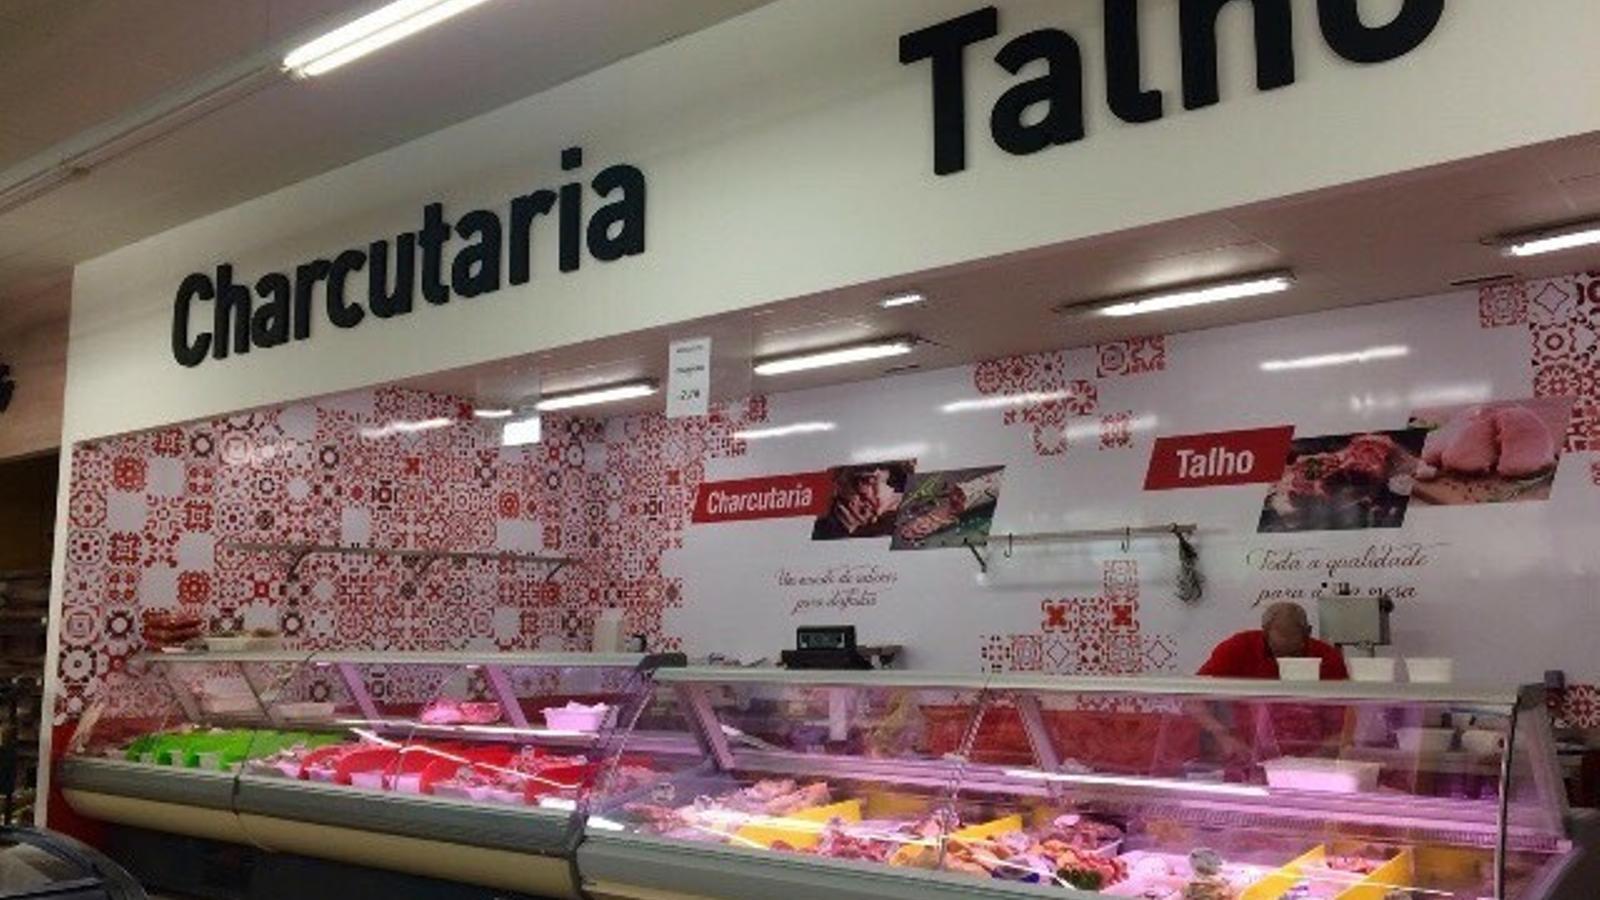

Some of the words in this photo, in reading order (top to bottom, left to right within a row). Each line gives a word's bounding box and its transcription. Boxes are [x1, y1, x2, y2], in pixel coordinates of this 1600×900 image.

[171, 147, 647, 367] Charcutaria
[1176, 447, 1255, 478] Talho
[706, 484, 813, 514] Charcutaria
[1325, 542, 1430, 577] qualidade
